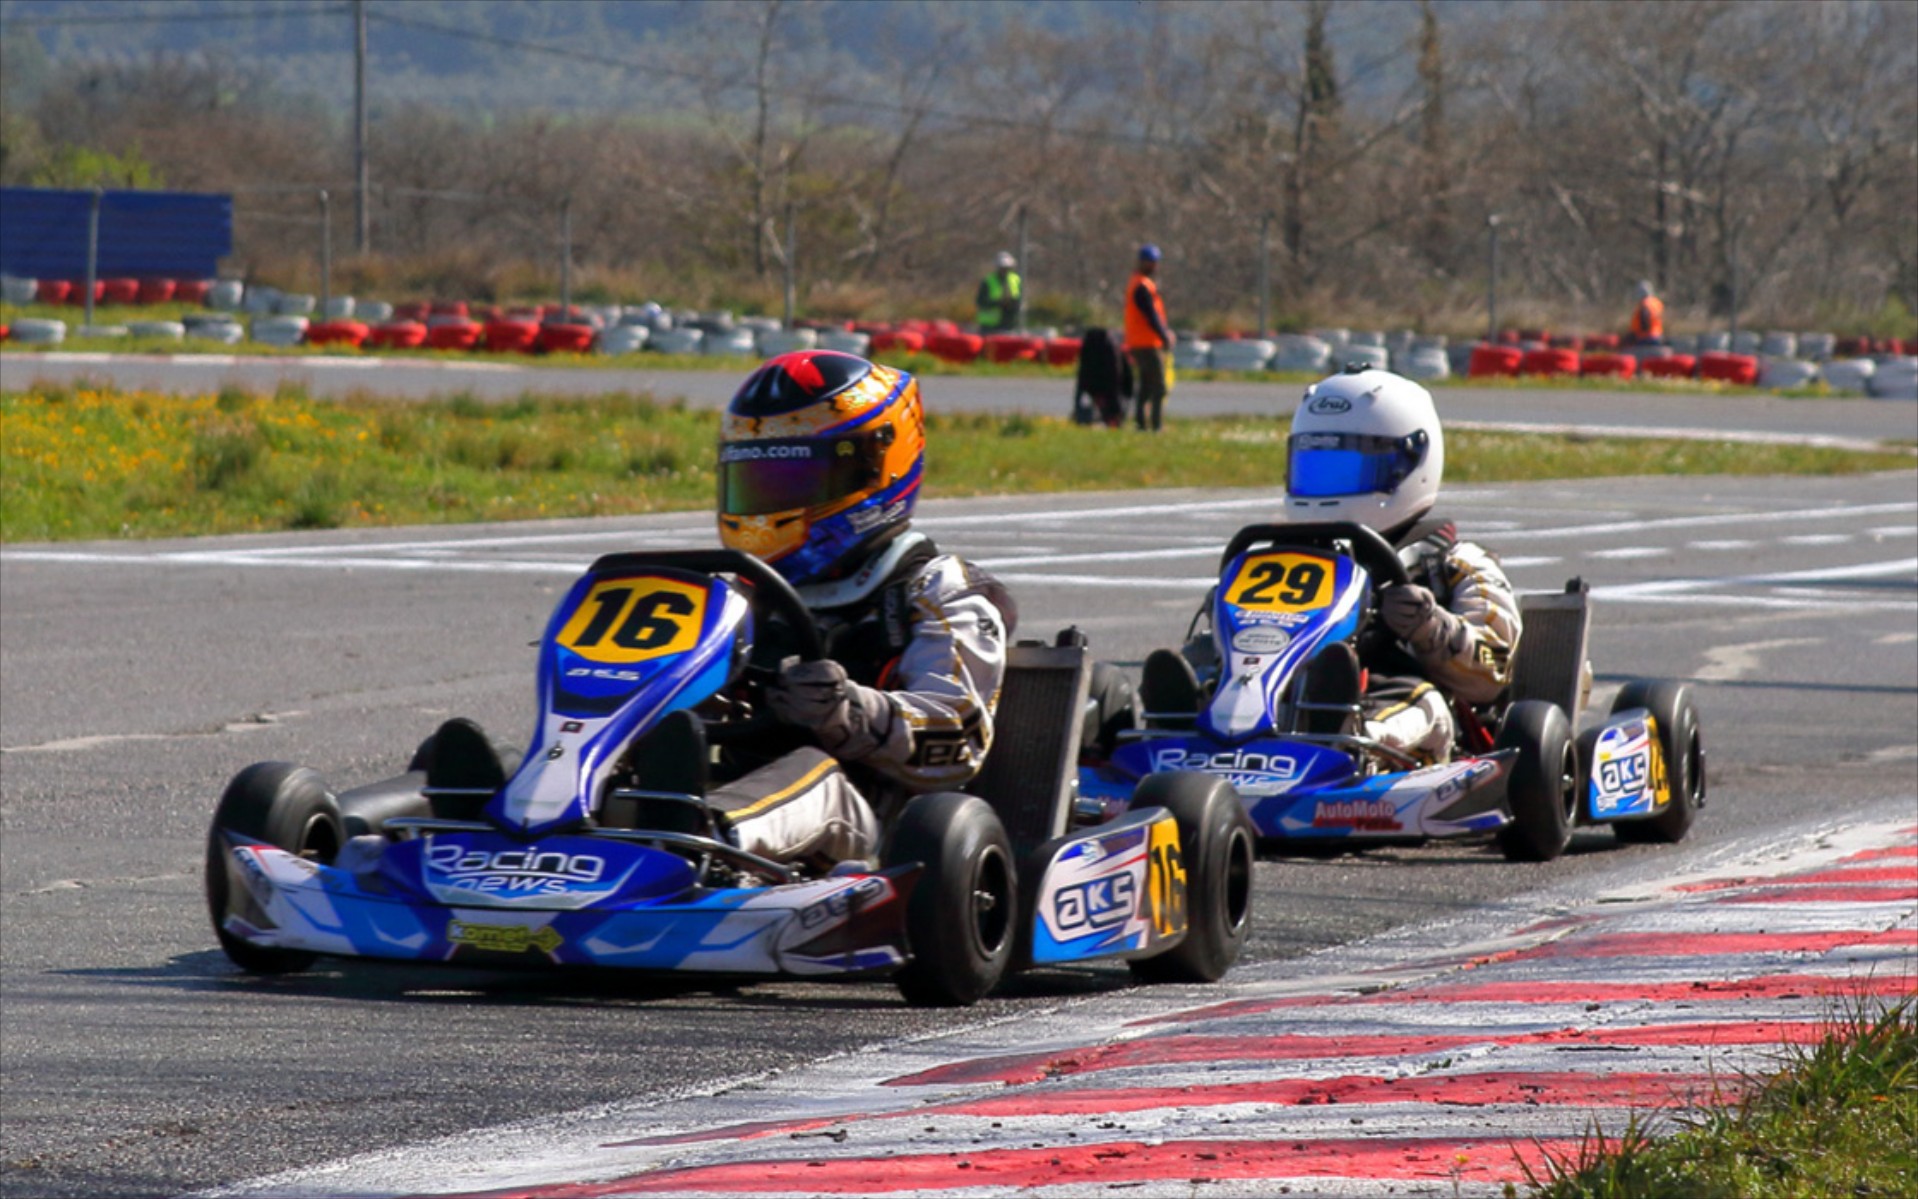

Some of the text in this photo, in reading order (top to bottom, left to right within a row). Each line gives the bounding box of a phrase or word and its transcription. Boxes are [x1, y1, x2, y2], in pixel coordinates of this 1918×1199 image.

[1238, 562, 1326, 605] 29
[571, 588, 696, 650] 16
[1154, 749, 1296, 778] Racing
[425, 842, 605, 882] Racing
[451, 876, 568, 894] news
